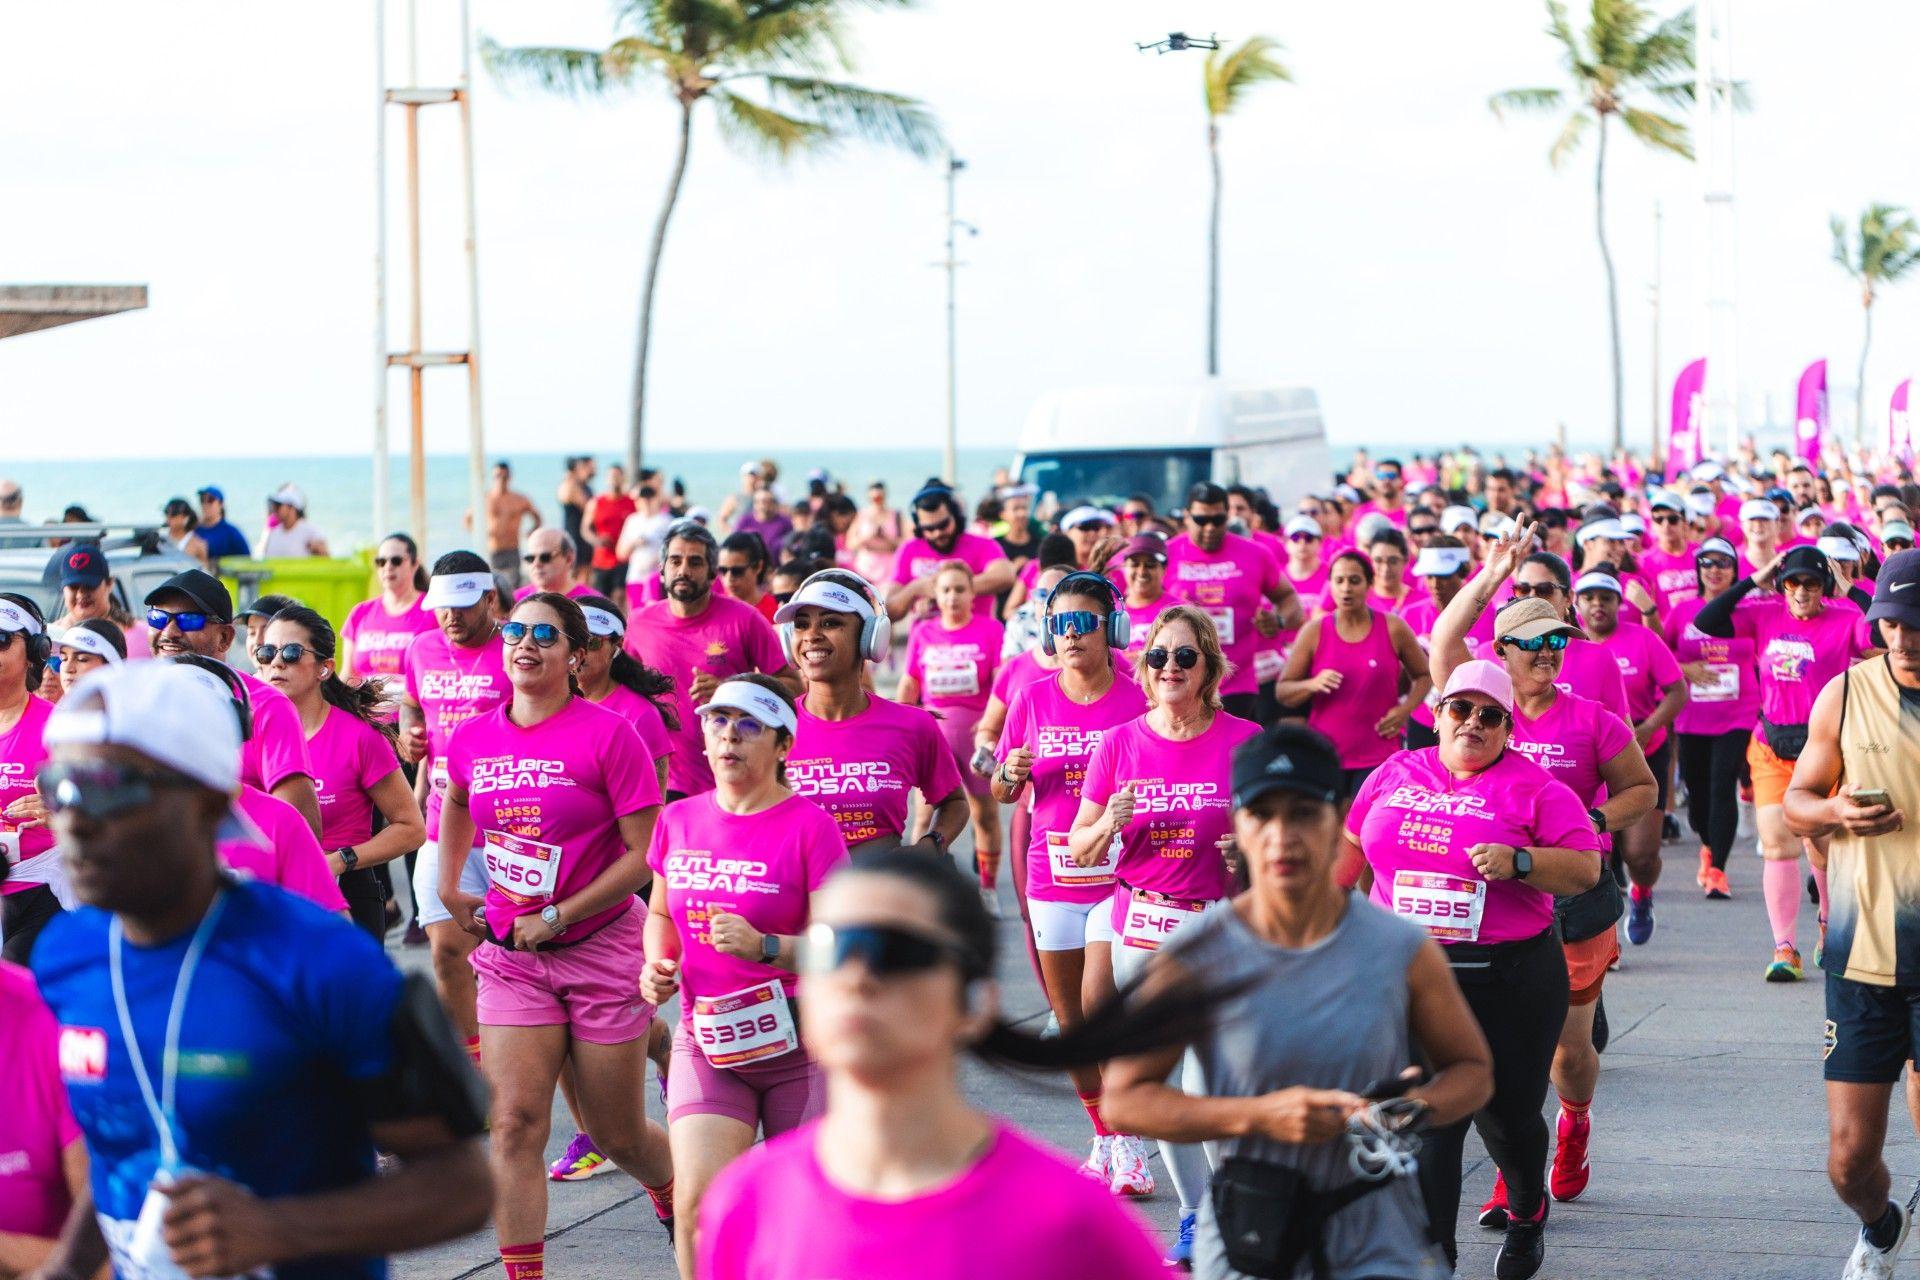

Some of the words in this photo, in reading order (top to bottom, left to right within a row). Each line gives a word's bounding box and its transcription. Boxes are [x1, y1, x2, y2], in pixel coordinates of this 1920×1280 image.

[1039, 730, 1103, 743] OUTUB
[1507, 739, 1565, 756] UBRO
[473, 758, 565, 779] OUTUBRO
[791, 757, 833, 767] CIRCUITO
[785, 761, 891, 781] OUTUBRO
[471, 772, 536, 795] ROSA
[1134, 782, 1218, 798] UTUBRO
[495, 805, 541, 819] passo
[1133, 796, 1191, 814] OSA
[833, 811, 874, 823] asso
[845, 827, 878, 840] udo
[1150, 828, 1195, 840] passo
[1401, 820, 1453, 837] passo
[1160, 847, 1193, 859] tudo
[1407, 838, 1449, 855] tudo
[486, 853, 543, 887] 5450
[667, 857, 768, 877] OUTUBRO
[667, 871, 733, 892] ROSA
[1397, 897, 1471, 918] 5335
[1131, 912, 1180, 934] 546
[700, 1013, 777, 1045] 5338
